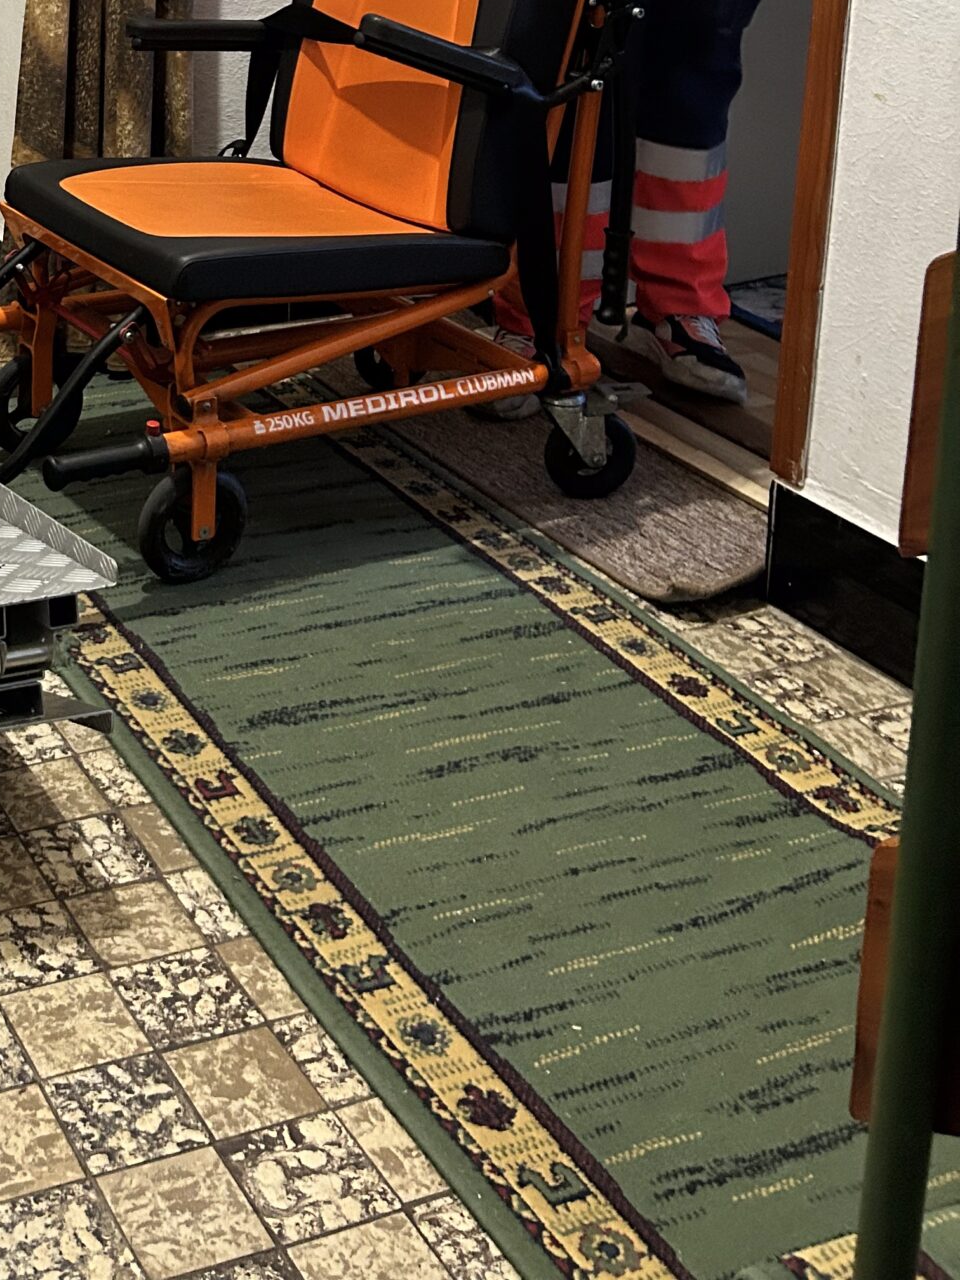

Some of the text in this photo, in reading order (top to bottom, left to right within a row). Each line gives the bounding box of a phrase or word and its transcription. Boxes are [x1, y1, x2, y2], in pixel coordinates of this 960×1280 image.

[268, 369, 536, 433] 250KG MEDIROL CLUBMAN
